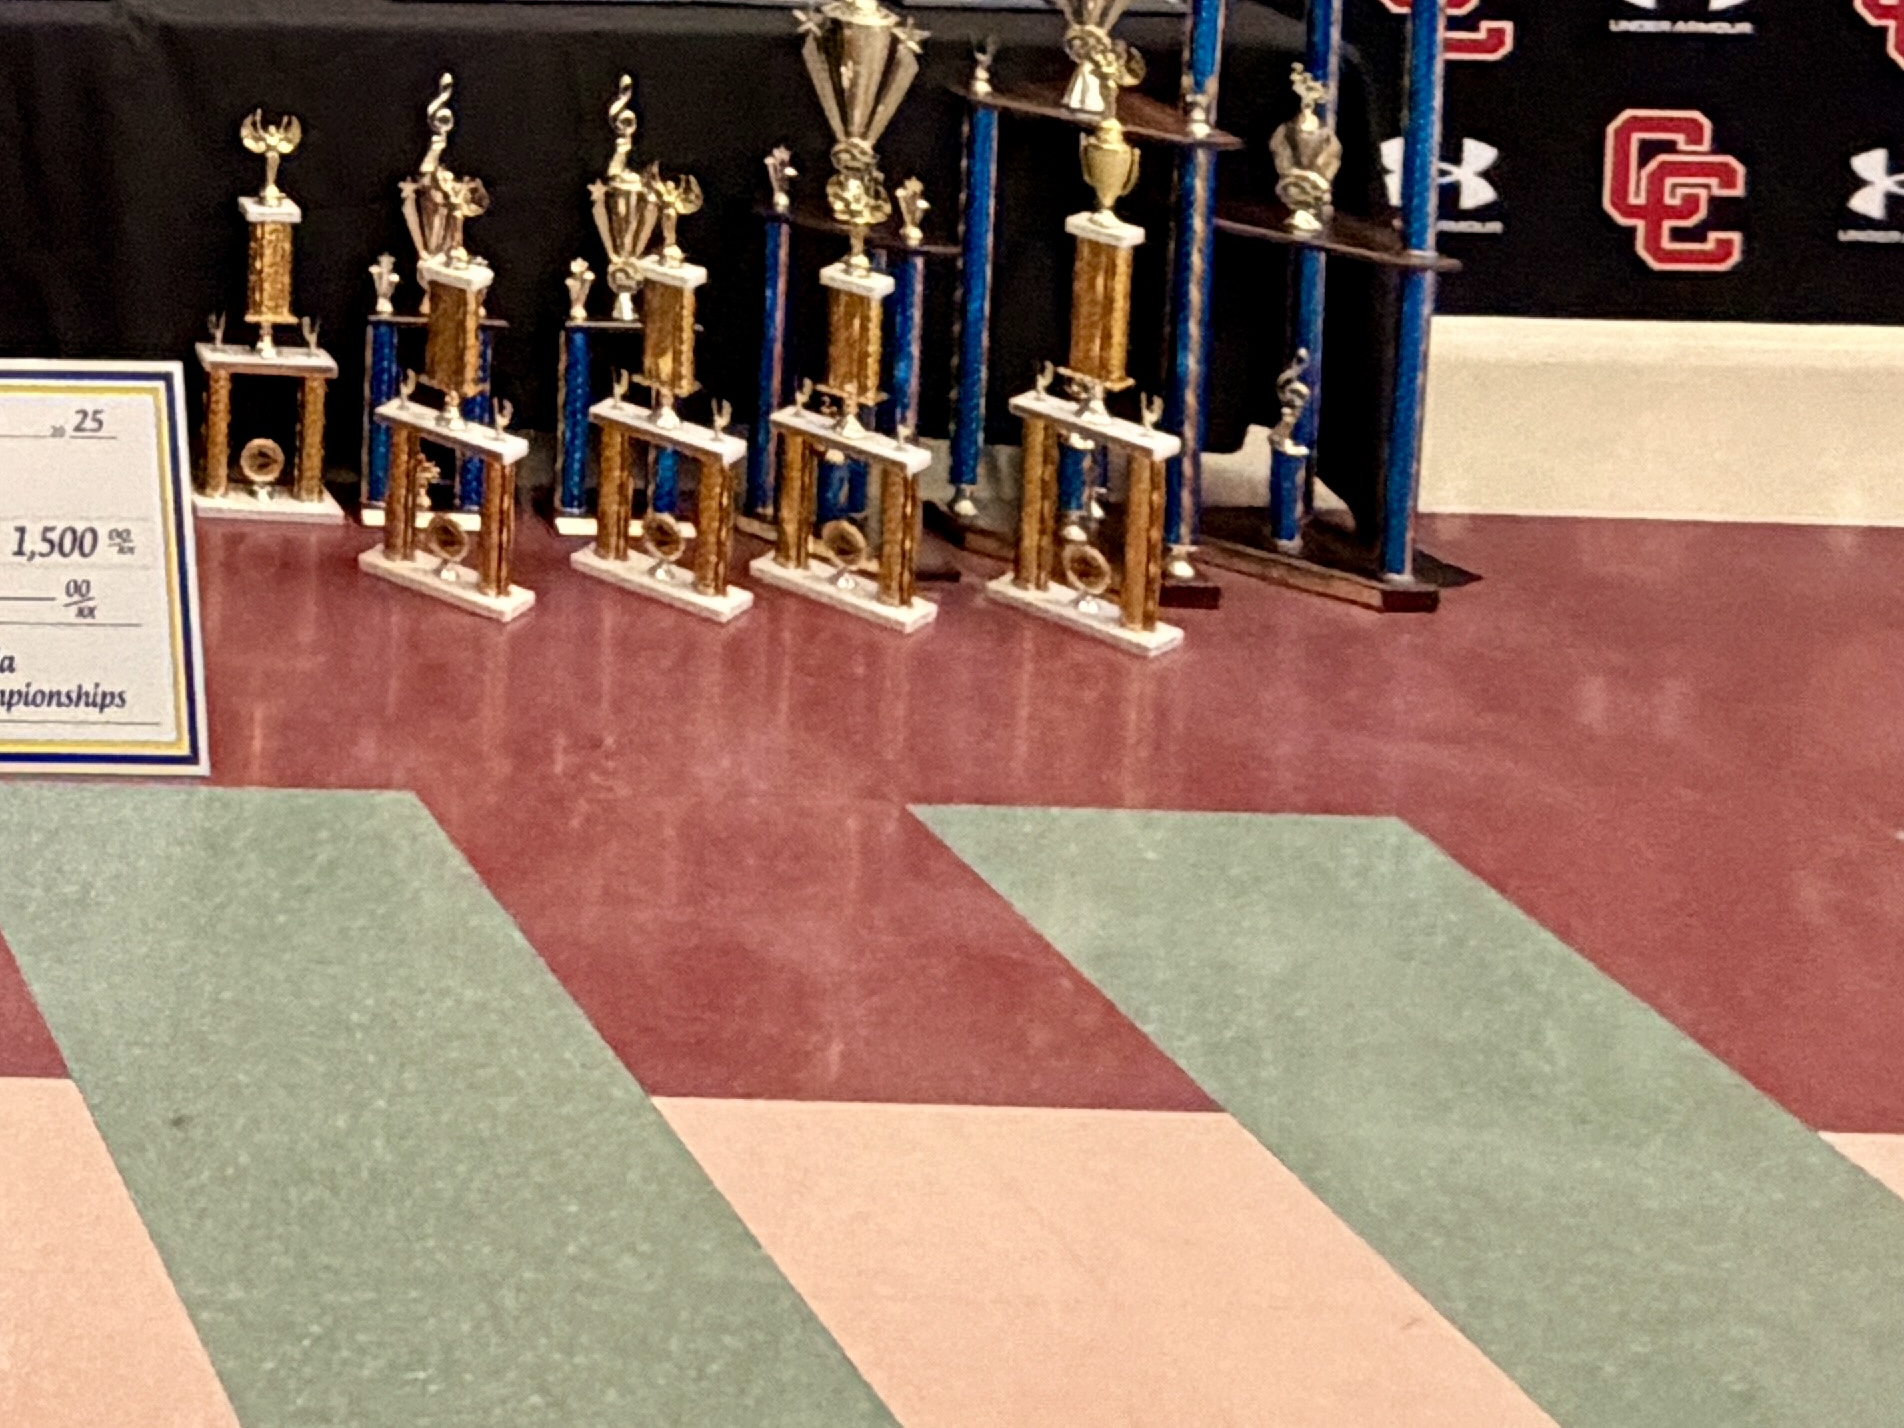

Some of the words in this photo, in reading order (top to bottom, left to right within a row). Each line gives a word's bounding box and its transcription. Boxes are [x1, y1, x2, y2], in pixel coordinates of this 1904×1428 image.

[1602, 108, 1746, 273] CC
[73, 410, 104, 433] 25
[11, 526, 98, 561] 1,500
